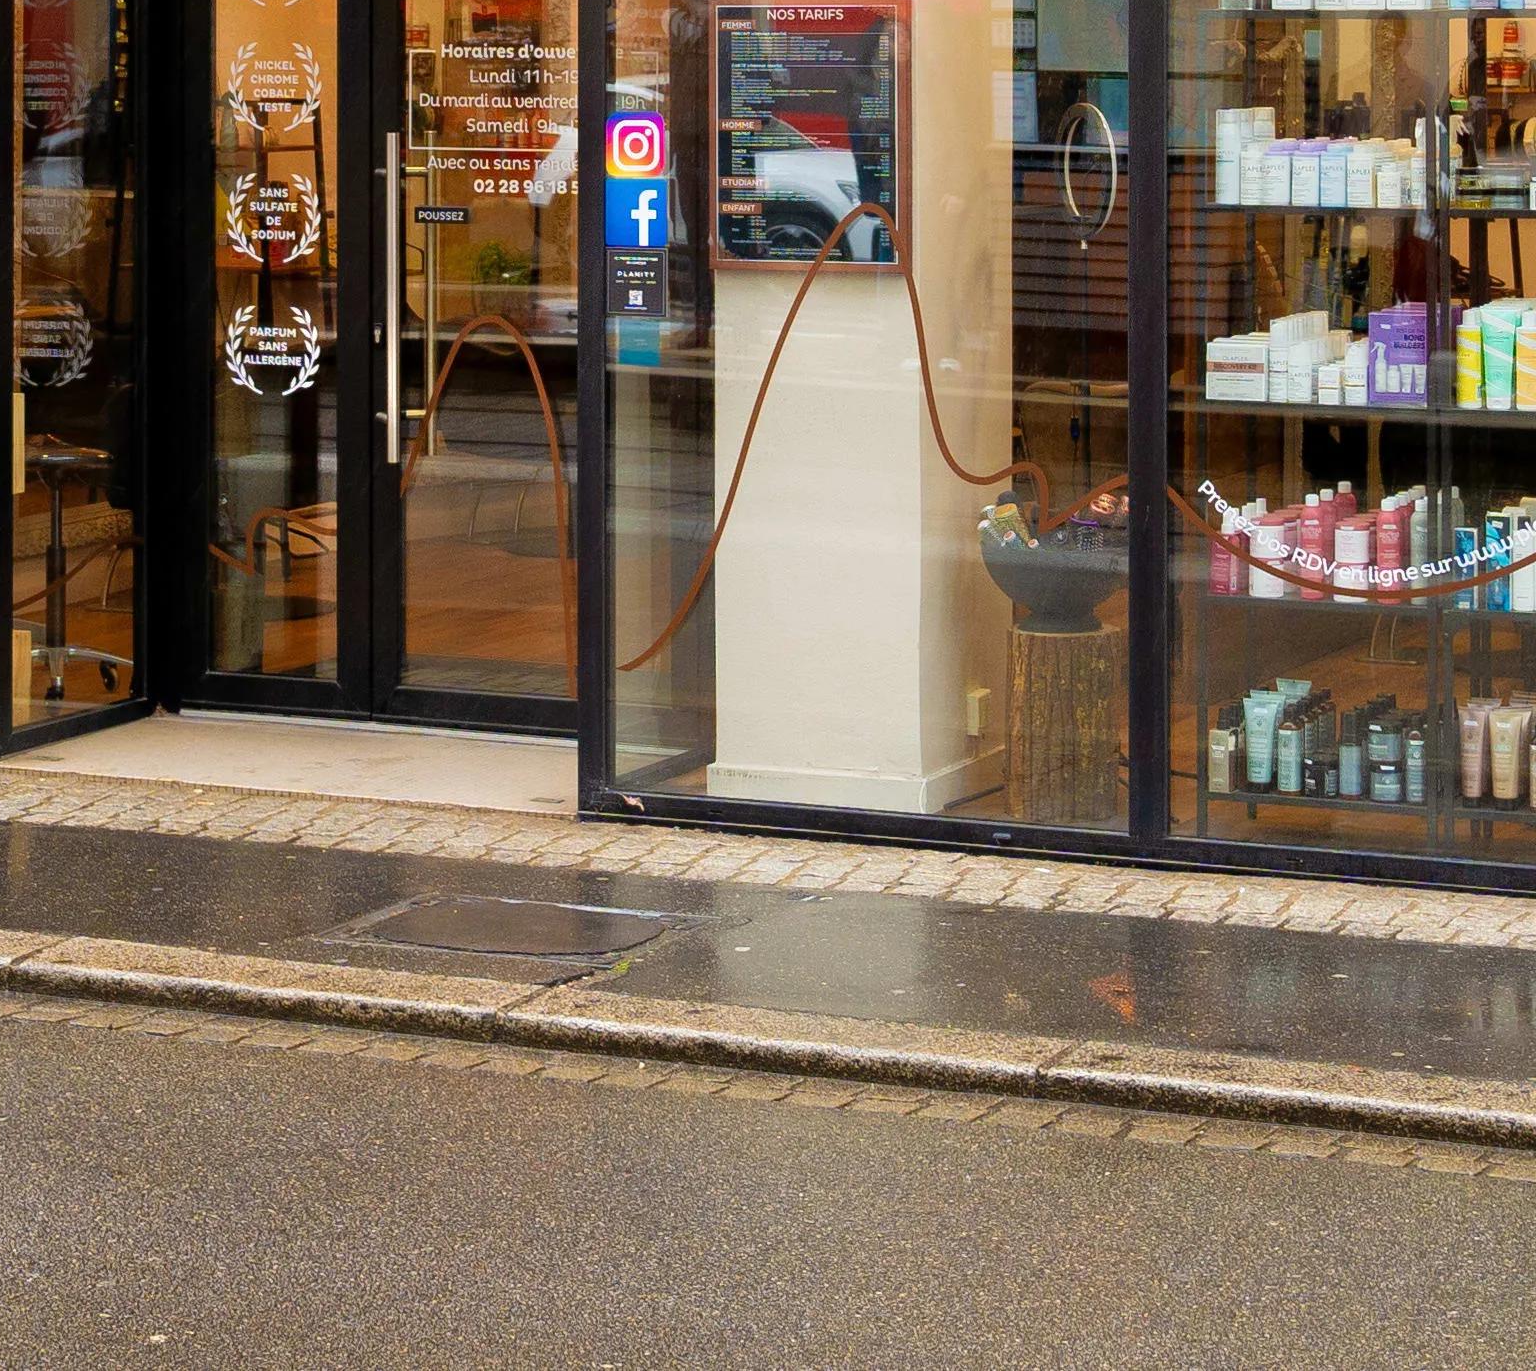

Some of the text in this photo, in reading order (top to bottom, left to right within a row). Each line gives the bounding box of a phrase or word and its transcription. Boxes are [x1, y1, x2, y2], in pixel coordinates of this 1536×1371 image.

[766, 8, 845, 21] NOS TARIFS
[721, 21, 752, 30] FEMME
[440, 42, 578, 60] Horaires d'ouve
[254, 60, 296, 71] NICKEL
[250, 74, 299, 85] CHROME
[469, 68, 516, 84] Lundi
[253, 88, 296, 99] COBALT
[419, 92, 441, 108] Du
[443, 92, 489, 108] mardi
[491, 95, 513, 108] au
[514, 93, 578, 110] vendred
[257, 102, 292, 113] TESTE
[466, 118, 530, 134] Samedi
[721, 120, 755, 130] HOMME
[427, 155, 578, 171] Avec ou sans rende
[473, 179, 495, 194] 02
[498, 179, 520, 194] 28
[523, 179, 545, 194] 96
[550, 179, 568, 194] 18
[722, 178, 765, 187] ETUDIANT
[259, 187, 289, 198] SANS
[249, 200, 298, 212] SULFATE
[722, 203, 756, 213] ENFANT
[265, 215, 282, 226] DE
[418, 210, 464, 221] POUSSEZ
[250, 229, 296, 241] SODIUM
[249, 326, 297, 338] PARFUM
[257, 341, 288, 352] SANS
[244, 352, 302, 366] ALLERGÈNE
[1197, 479, 1257, 537] Prenez
[1257, 529, 1291, 558] vos
[1291, 547, 1338, 576] RDV
[1339, 566, 1365, 583] en
[1367, 565, 1420, 587] ligne
[1420, 557, 1453, 578] sur
